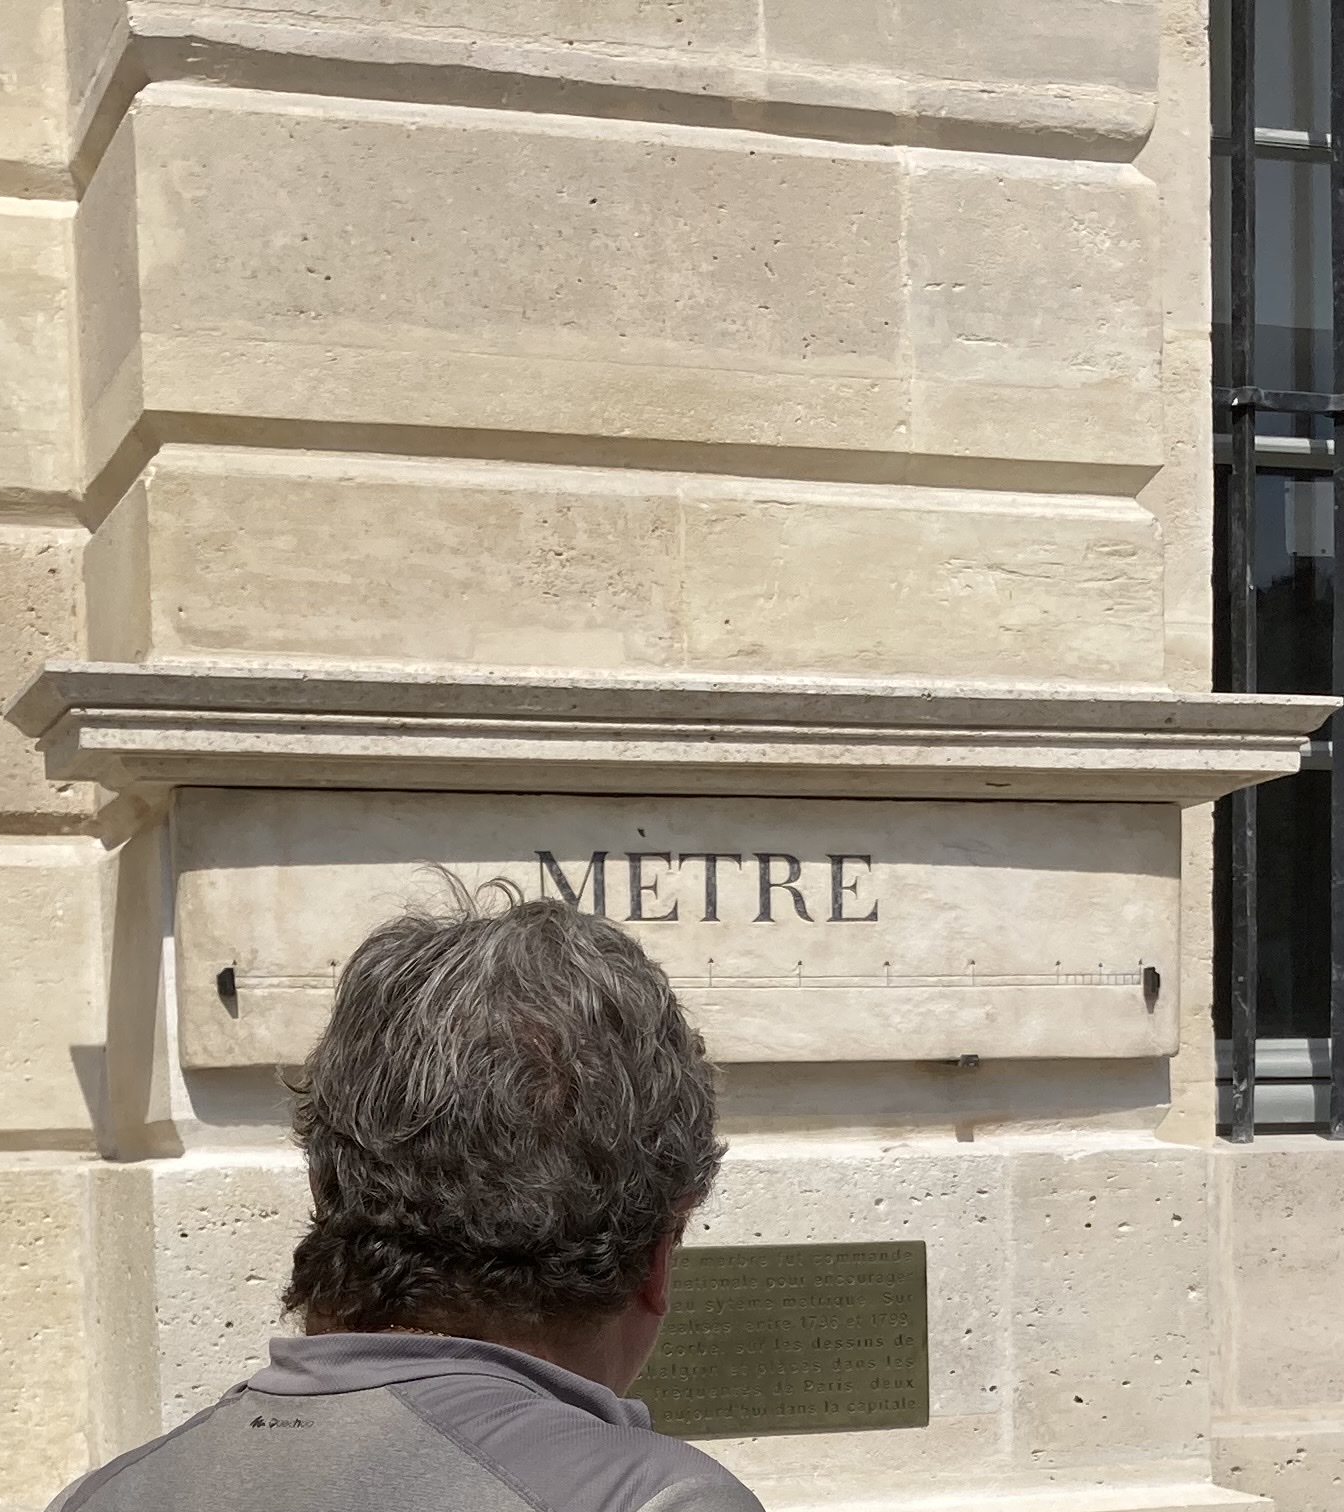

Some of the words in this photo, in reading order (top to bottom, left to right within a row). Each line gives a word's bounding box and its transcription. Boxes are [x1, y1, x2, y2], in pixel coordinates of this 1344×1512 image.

[701, 1252, 768, 1269] marbre
[777, 1251, 804, 1268] fut
[672, 1274, 759, 1292] nationale
[765, 1275, 806, 1292] pour
[814, 1271, 914, 1289] encourager
[673, 1300, 697, 1314] au
[881, 1291, 913, 1306] Sur
[742, 1318, 792, 1334] entre
[800, 1314, 839, 1330] 1796
[846, 1315, 863, 1330] et
[735, 1342, 765, 1355] sur
[774, 1338, 802, 1353] les
[811, 1336, 885, 1351] dessins
[893, 1334, 915, 1349] de
[831, 1357, 877, 1372] dans
[886, 1355, 915, 1370] les
[772, 1381, 794, 1396] de
[870, 1376, 915, 1391] deux
[776, 1402, 818, 1417] dans
[824, 1400, 840, 1415] la
